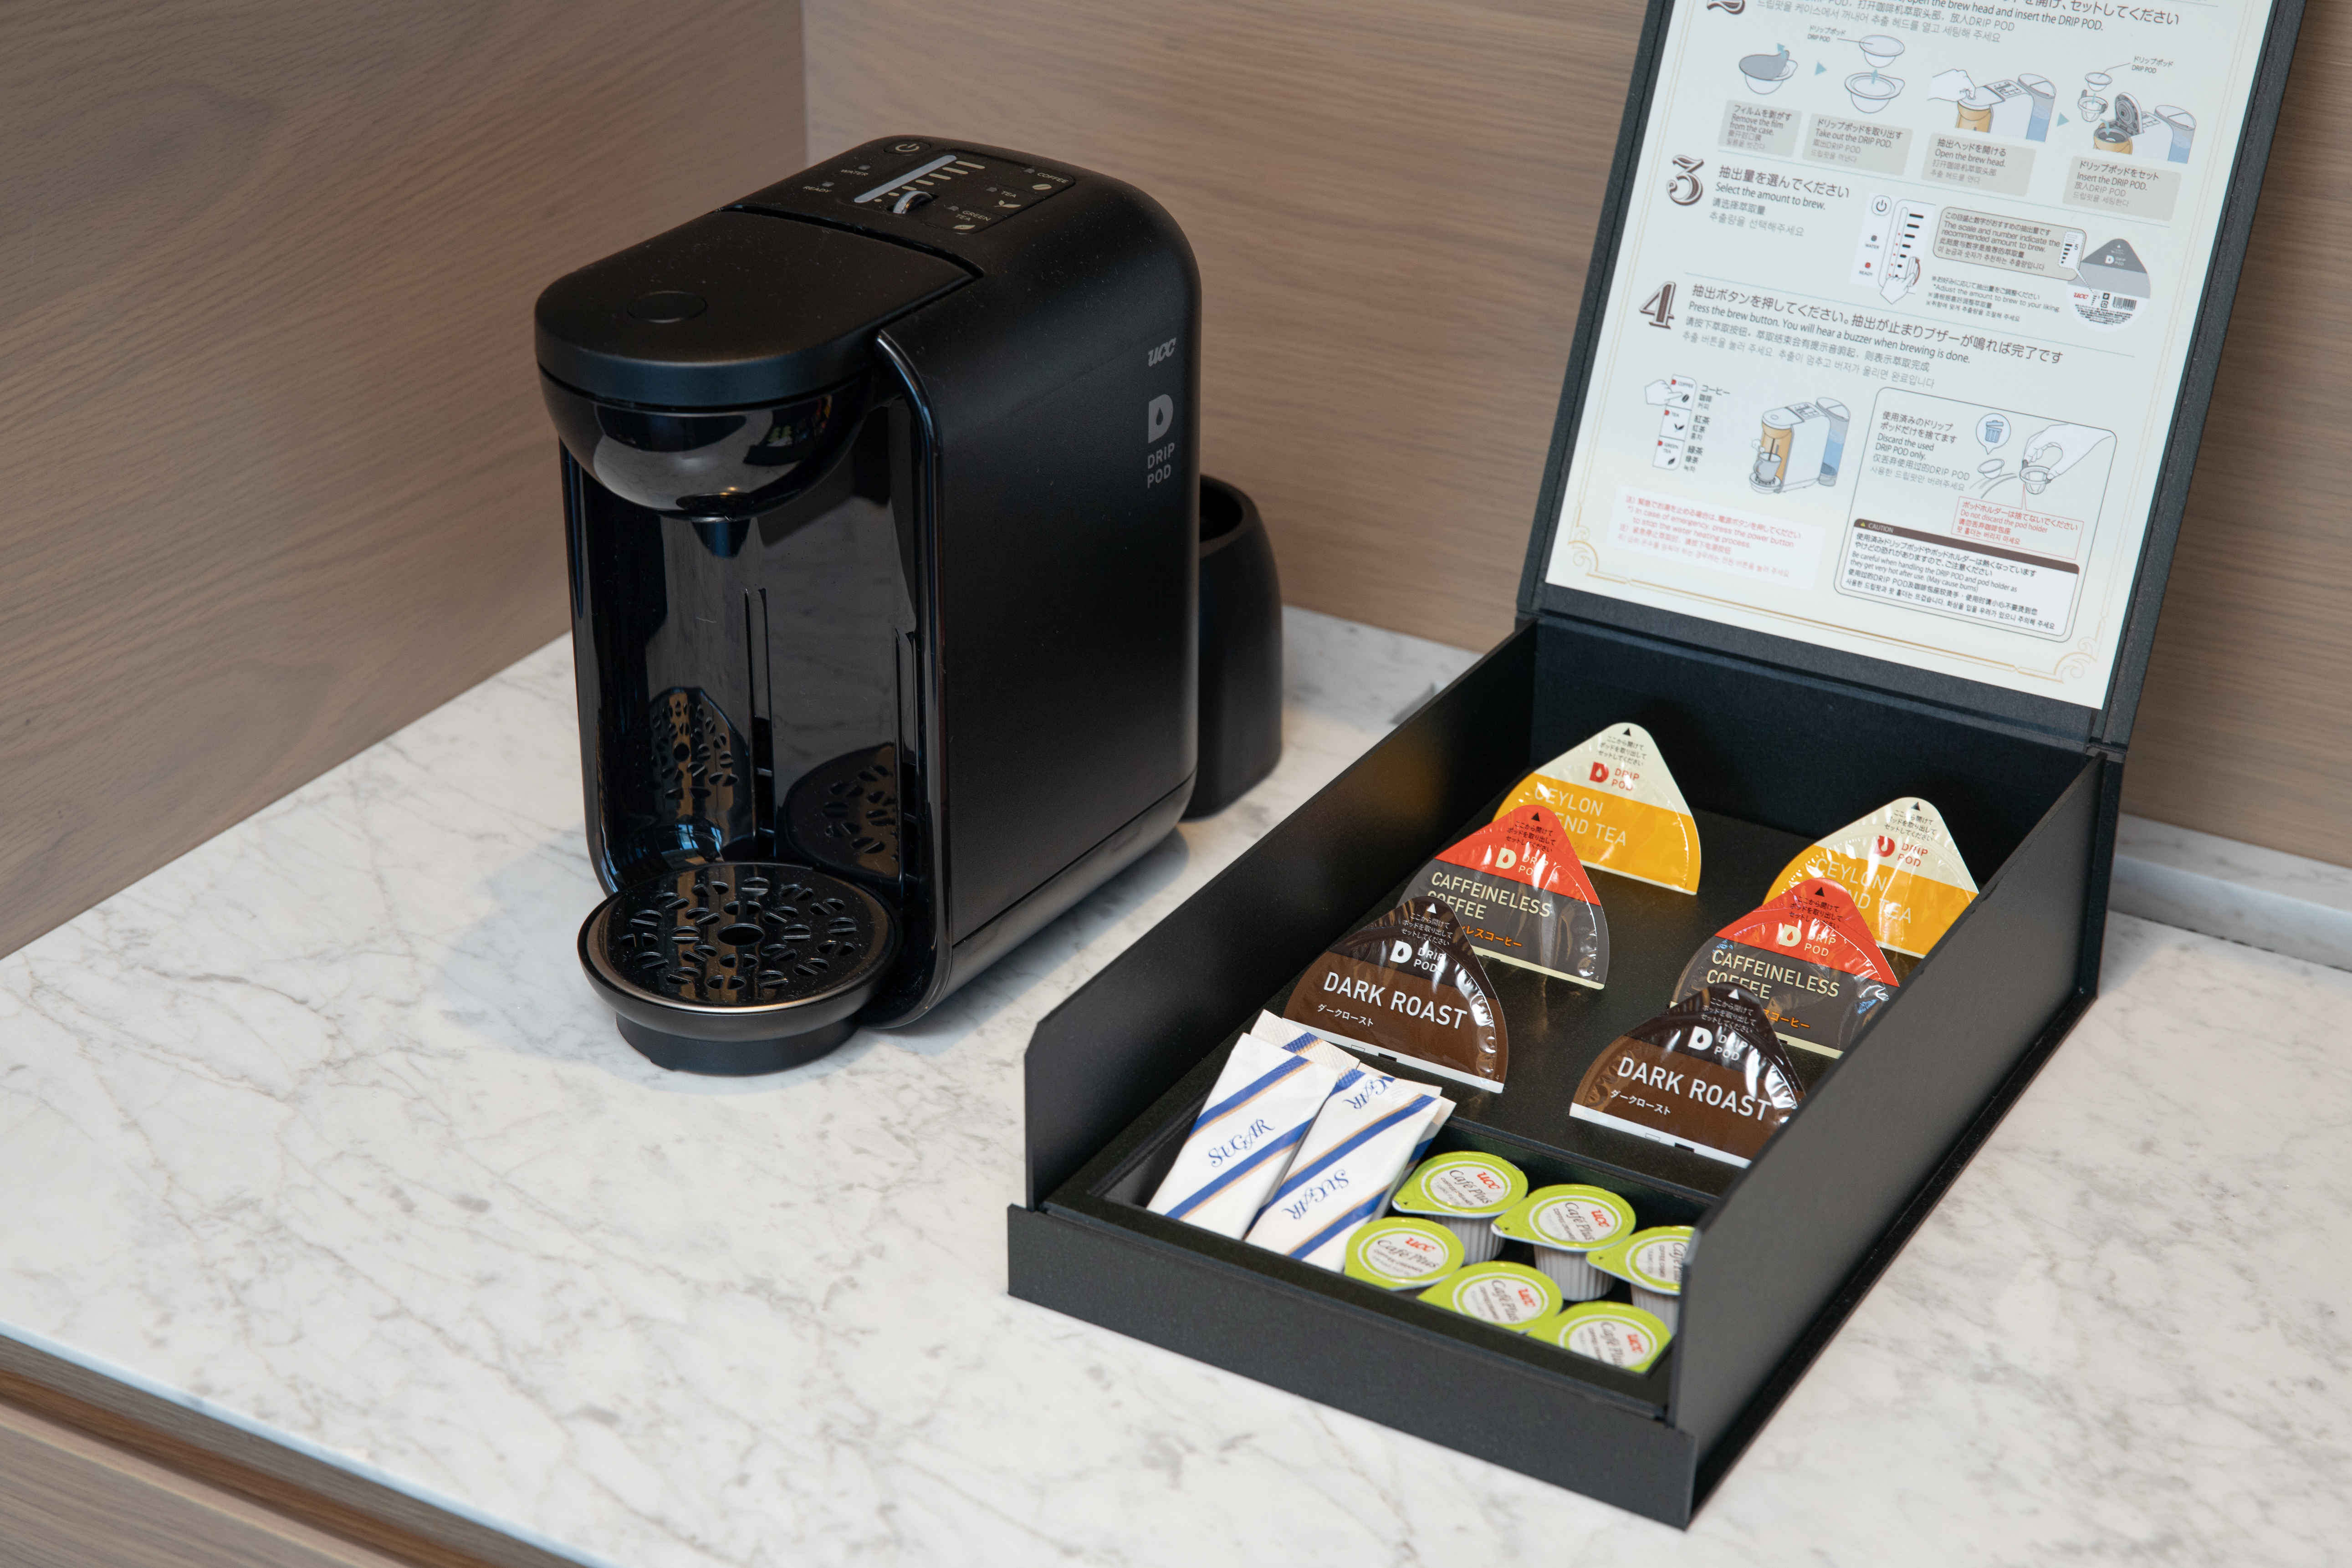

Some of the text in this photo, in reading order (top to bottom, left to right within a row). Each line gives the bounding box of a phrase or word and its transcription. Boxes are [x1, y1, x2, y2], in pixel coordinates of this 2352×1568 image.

[1947, 0, 1970, 11] brew
[1971, 2, 1995, 15] head
[1995, 7, 2014, 17] and
[2014, 9, 2040, 22] insert
[2041, 12, 2056, 24] the
[2057, 15, 2080, 27] DRIP
[2081, 18, 2103, 31] POD.
[2131, 64, 2157, 74] DRIP POD
[1729, 120, 1774, 136] from the case.
[1730, 112, 1784, 129] Remove the film
[1817, 118, 1903, 140] ドリップポッドを取り出す
[1815, 128, 1892, 148] Take out the DRIP POD.
[1936, 137, 2006, 158] 抽出ヘッドを開ける
[1934, 148, 2006, 168] Open the brew head.
[1037, 172, 1069, 184] COFFEE
[1718, 164, 1849, 198] 抽出量を選んでください
[2076, 171, 2147, 191] Insert the DRIP POD.
[2079, 160, 2159, 181] ドリップポッドをセット
[1714, 181, 1825, 210] Select the amount to brew.
[962, 210, 991, 221] GREEN
[1943, 220, 2061, 248] The scale and number indicate the
[1688, 300, 1970, 364] Press the brew button. You will hear a buzzer when brewing is done.
[1882, 410, 1954, 432] 使用済みのドリップ
[1876, 432, 1935, 452] Discard the used
[1879, 421, 1958, 444] ポッドだけを捨てます
[1148, 443, 1175, 470] DRIP
[1874, 442, 1926, 461] DRIP POD only.
[1147, 464, 1171, 489] POD
[1962, 501, 2078, 531] ポッドホルダーは捨てないでください
[1867, 522, 1894, 534] CAUTION
[1534, 787, 1603, 817] CEYLON
[1596, 823, 1626, 846] TEA
[1897, 853, 1921, 867] POD
[1432, 872, 1552, 917] CAFFEINELESS
[1410, 913, 1450, 929] ここから開けて
[1879, 898, 1911, 924] TEA
[1401, 928, 1449, 945] セットしてください
[1804, 943, 1829, 956] POD
[1413, 958, 1437, 972] POD
[1713, 949, 1840, 997] CAFFEINELESS
[1324, 971, 1467, 1029] DARK ROAST
[1317, 1003, 1373, 1027] ダークロースト
[1714, 1046, 1740, 1061] POD
[1617, 1057, 1772, 1121] DARK ROAST
[1610, 1089, 1670, 1115] ダークロースト
[1208, 1119, 1275, 1167] SUGAR
[1282, 1170, 1349, 1220] SUGAR
[1449, 1170, 1477, 1189] Café
[1468, 1188, 1492, 1204] Plus
[1565, 1202, 1595, 1241] Café Plus
[1378, 1240, 1412, 1257] Café
